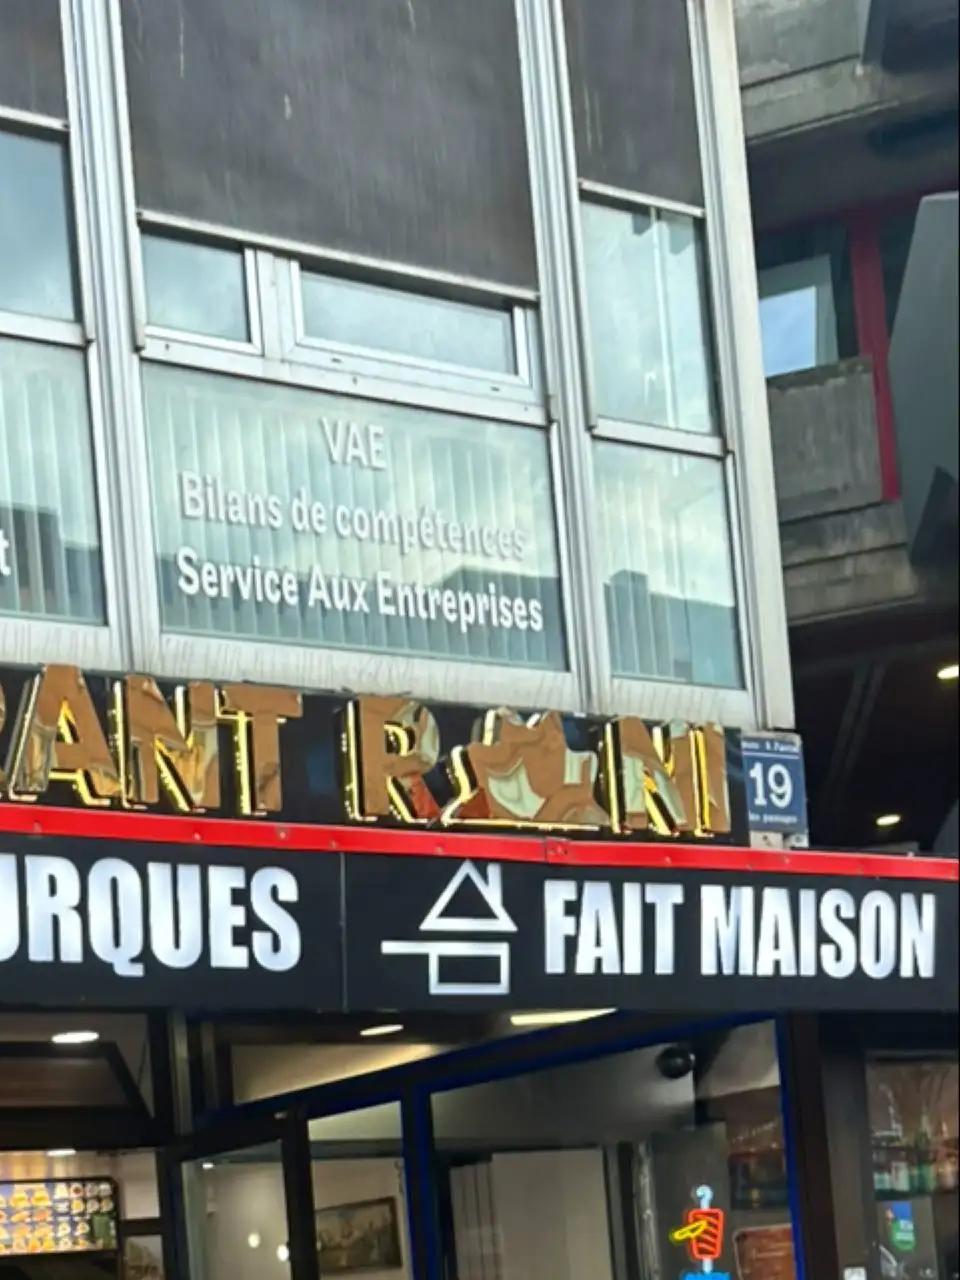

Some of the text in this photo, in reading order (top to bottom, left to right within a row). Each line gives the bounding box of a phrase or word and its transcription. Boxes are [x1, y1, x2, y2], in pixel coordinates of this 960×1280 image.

[322, 417, 387, 469] VAE
[180, 471, 525, 560] Bilans de compétences
[177, 547, 543, 633] Service Aux Entreprises
[749, 762, 793, 808] 19
[544, 879, 684, 975] FAIT
[700, 885, 936, 979] MAISON
